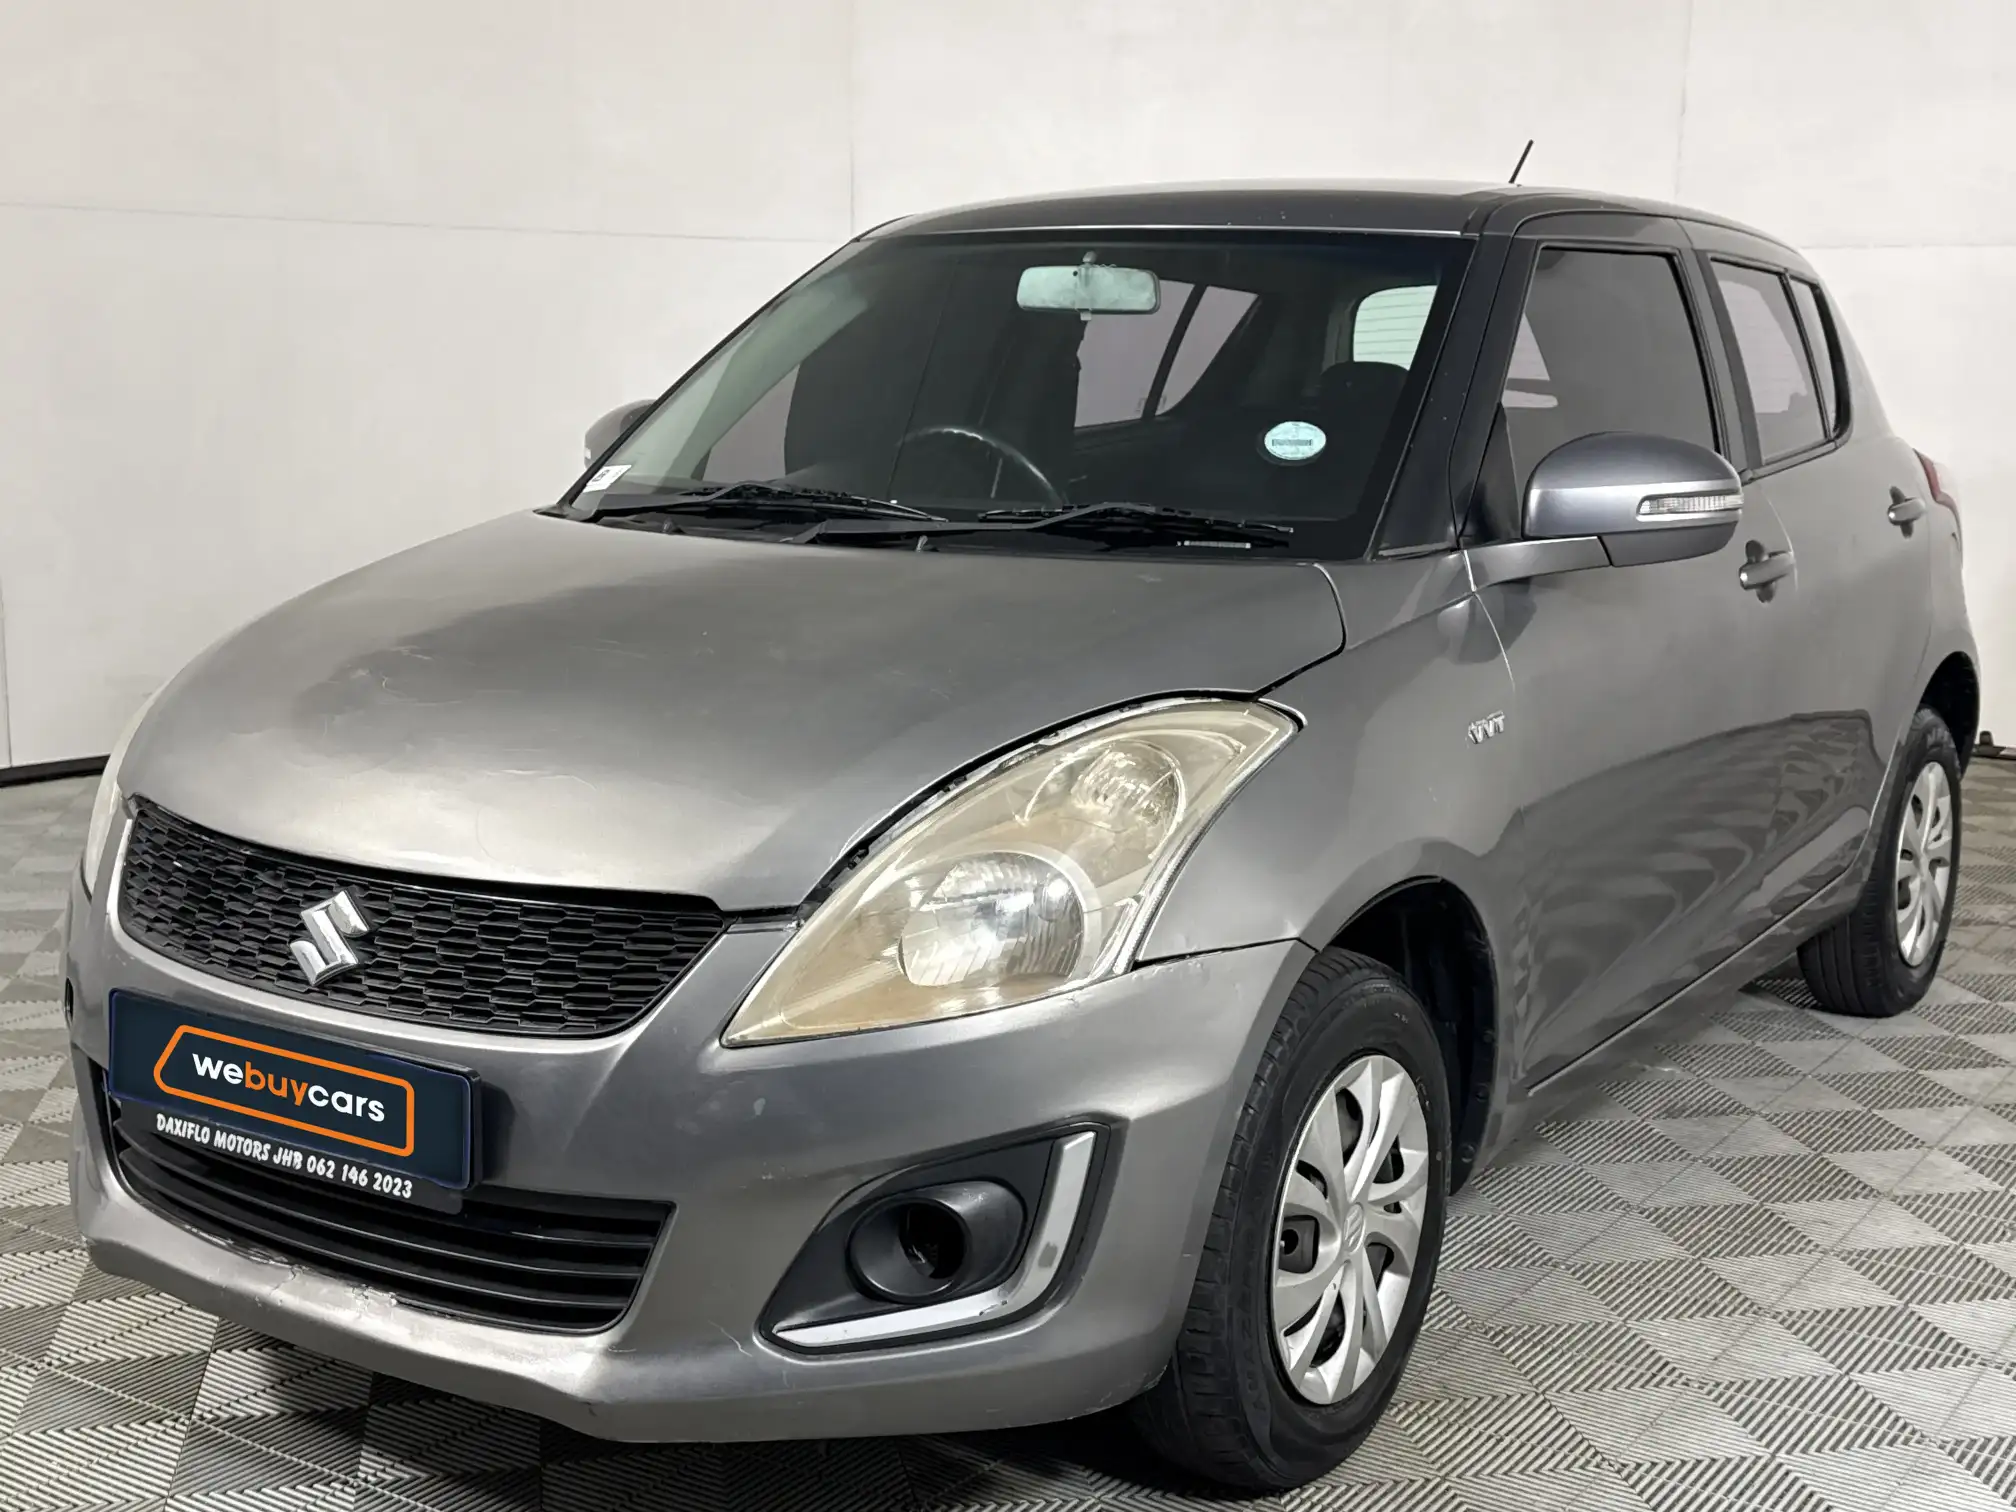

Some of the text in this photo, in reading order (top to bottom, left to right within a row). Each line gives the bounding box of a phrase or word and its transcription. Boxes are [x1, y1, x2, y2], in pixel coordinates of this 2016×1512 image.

[156, 1113, 414, 1200] DAXIFLO MOTORS JHB 062 146 2023
